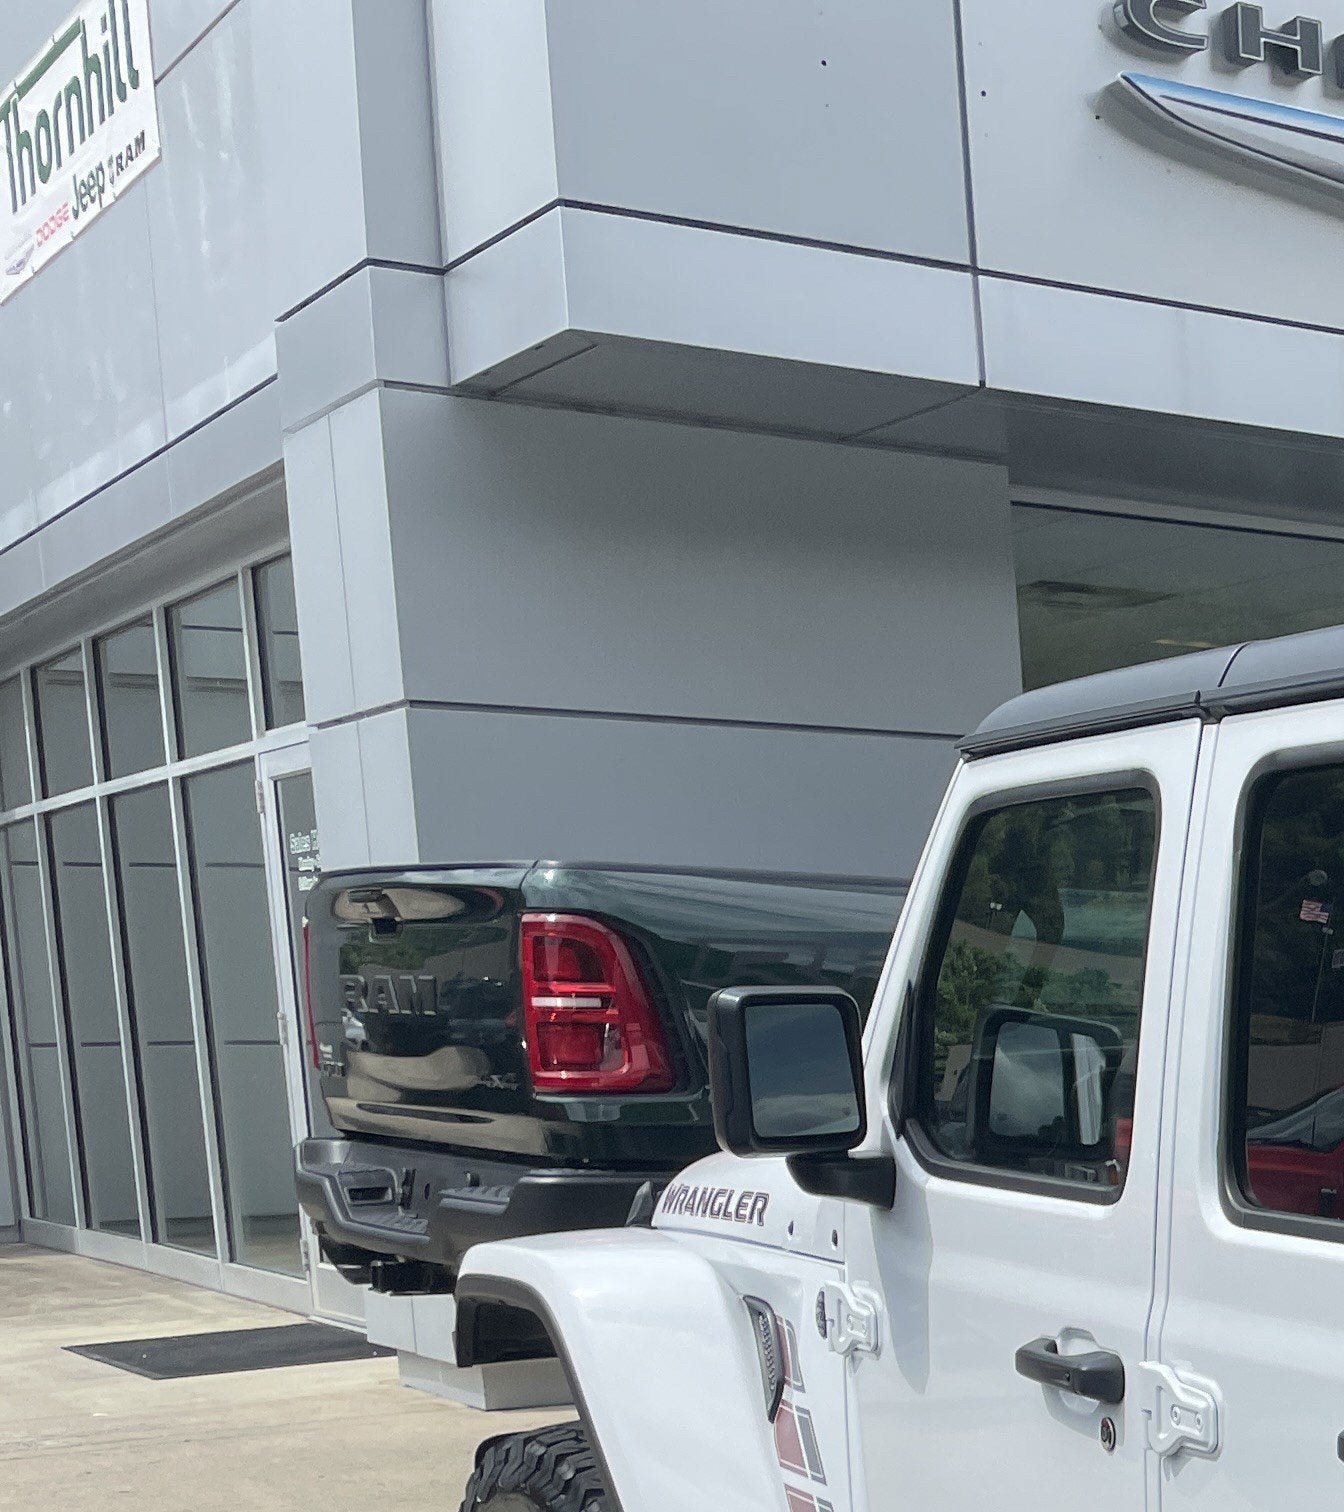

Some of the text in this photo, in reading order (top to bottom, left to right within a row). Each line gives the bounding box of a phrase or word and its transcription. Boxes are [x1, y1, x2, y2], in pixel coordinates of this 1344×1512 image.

[0, 0, 140, 215] Thornhill
[34, 201, 71, 249] DODGE
[71, 160, 106, 221] Jeep
[115, 129, 147, 177] RAM
[338, 973, 438, 1016] RAM
[660, 1183, 771, 1227] WRANGLER
